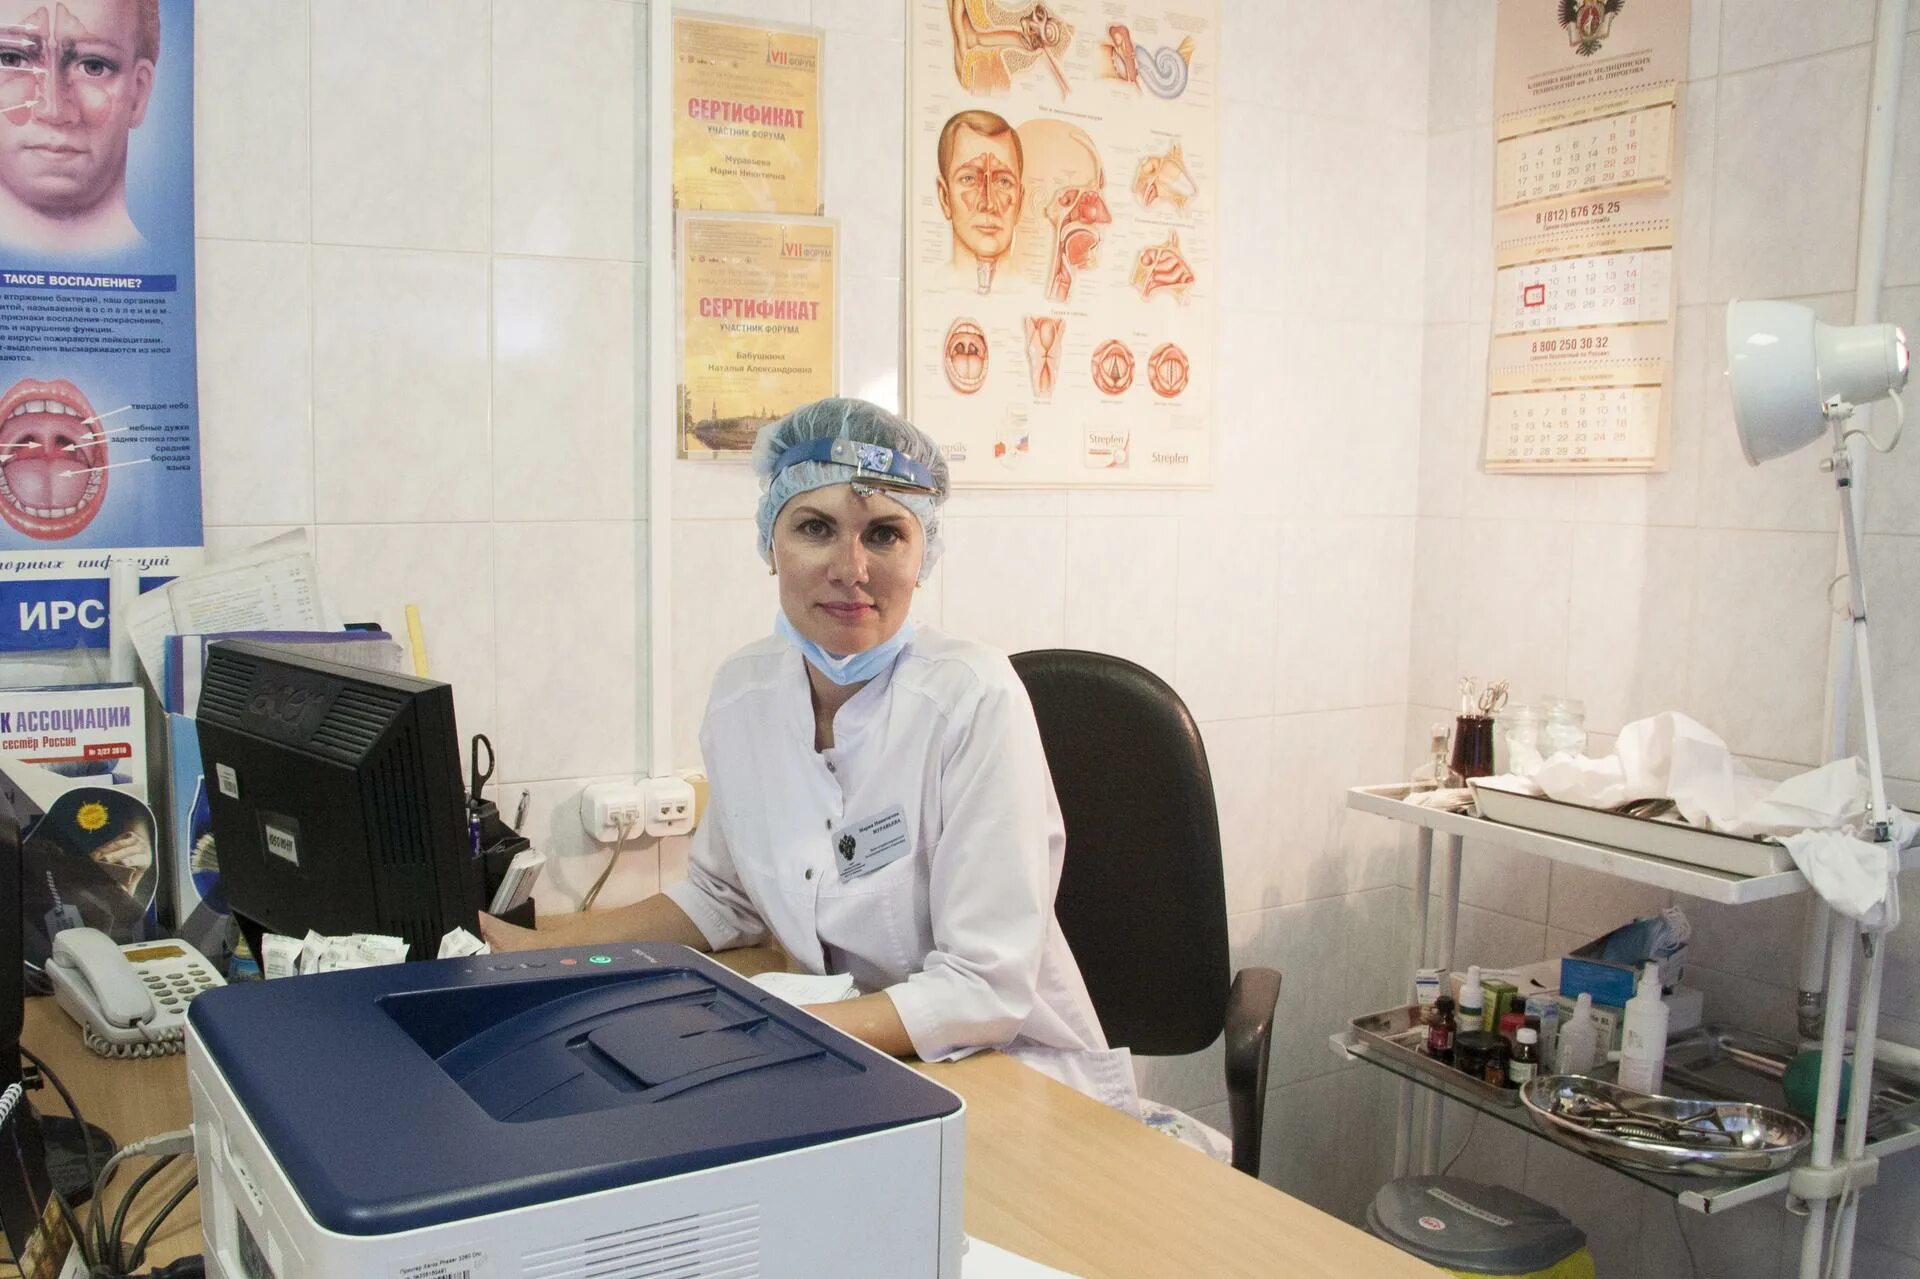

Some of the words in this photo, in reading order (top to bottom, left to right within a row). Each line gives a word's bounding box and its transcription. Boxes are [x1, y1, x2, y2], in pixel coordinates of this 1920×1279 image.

[771, 50, 788, 65] VII
[688, 98, 805, 129] СЕРТИФИКАТ
[707, 125, 750, 138] УЧАСТНИК
[751, 130, 786, 142] ФОРУМА
[1536, 213, 1541, 224] 8
[1544, 208, 1568, 223] (812)
[1570, 206, 1589, 218] 676
[1592, 203, 1604, 215] 25
[1607, 201, 1620, 214] 25
[785, 243, 803, 258] VII
[803, 248, 832, 259] ФОРУМ
[3, 274, 45, 285] ТАКОЕ
[49, 275, 142, 288] ВОСПАЛЕНИЕ?
[4, 294, 53, 303] вторжение
[123, 298, 166, 307] организм
[27, 305, 83, 313] называемой
[699, 297, 819, 321] СЕРТИФИКАТ
[1, 314, 45, 323] признаки
[20, 325, 71, 333] нарушение
[720, 322, 762, 334] УЧАСТНИК
[764, 325, 800, 335] ФОРУМА
[8, 335, 42, 343] вирусы
[43, 336, 100, 345] пожираются
[1532, 342, 1537, 353] 8
[1540, 340, 1557, 352] 800
[1560, 338, 1577, 351] 250
[1580, 337, 1592, 349] 30
[1595, 336, 1609, 348] 32
[736, 351, 786, 362] Бабушкина
[746, 364, 813, 376] Александровна
[131, 403, 167, 412] твердое
[169, 402, 189, 410] небо
[1088, 433, 1124, 447] Strepfen
[1151, 451, 1189, 464] Strepfen
[19, 599, 109, 632] ИРС
[16, 706, 131, 733] АССОЦИАЦИИ
[2, 737, 39, 751] сестёр
[42, 736, 77, 748] России
